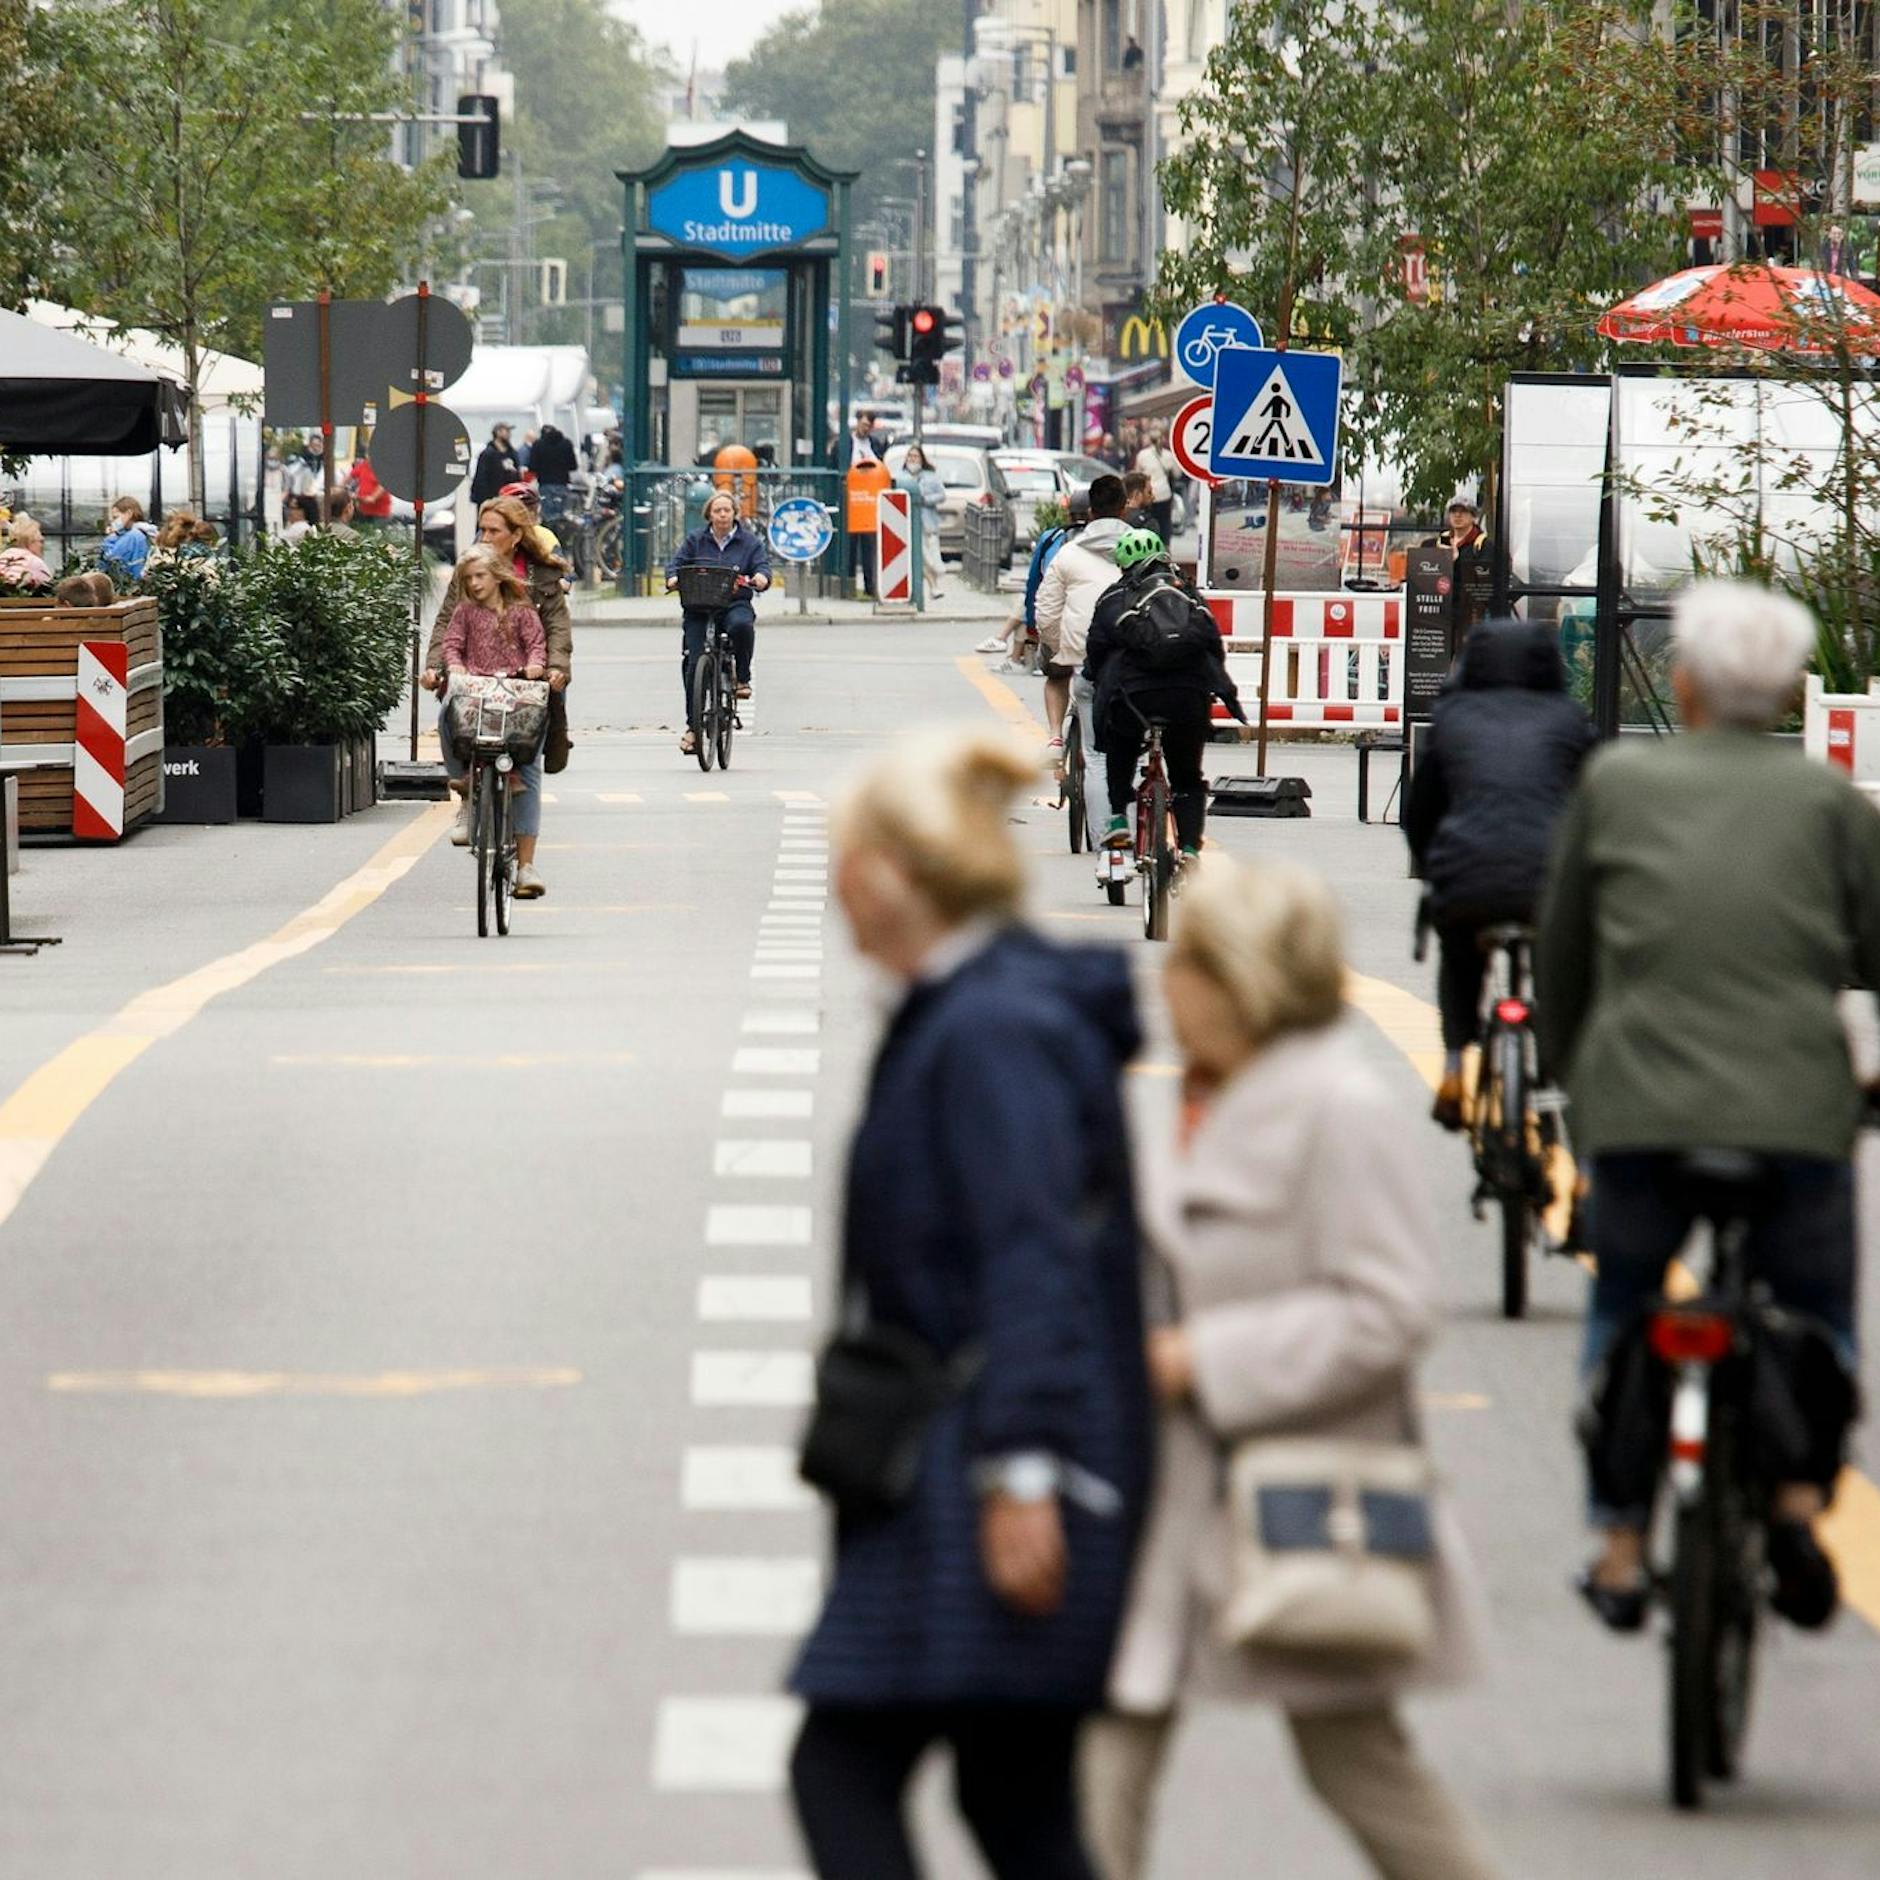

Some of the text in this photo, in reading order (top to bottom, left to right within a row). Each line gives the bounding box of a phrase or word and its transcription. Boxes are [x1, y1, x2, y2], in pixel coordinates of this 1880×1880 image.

[719, 170, 757, 218] U
[684, 220, 792, 241] Stadtmitte
[1416, 595, 1443, 603] STELLE
